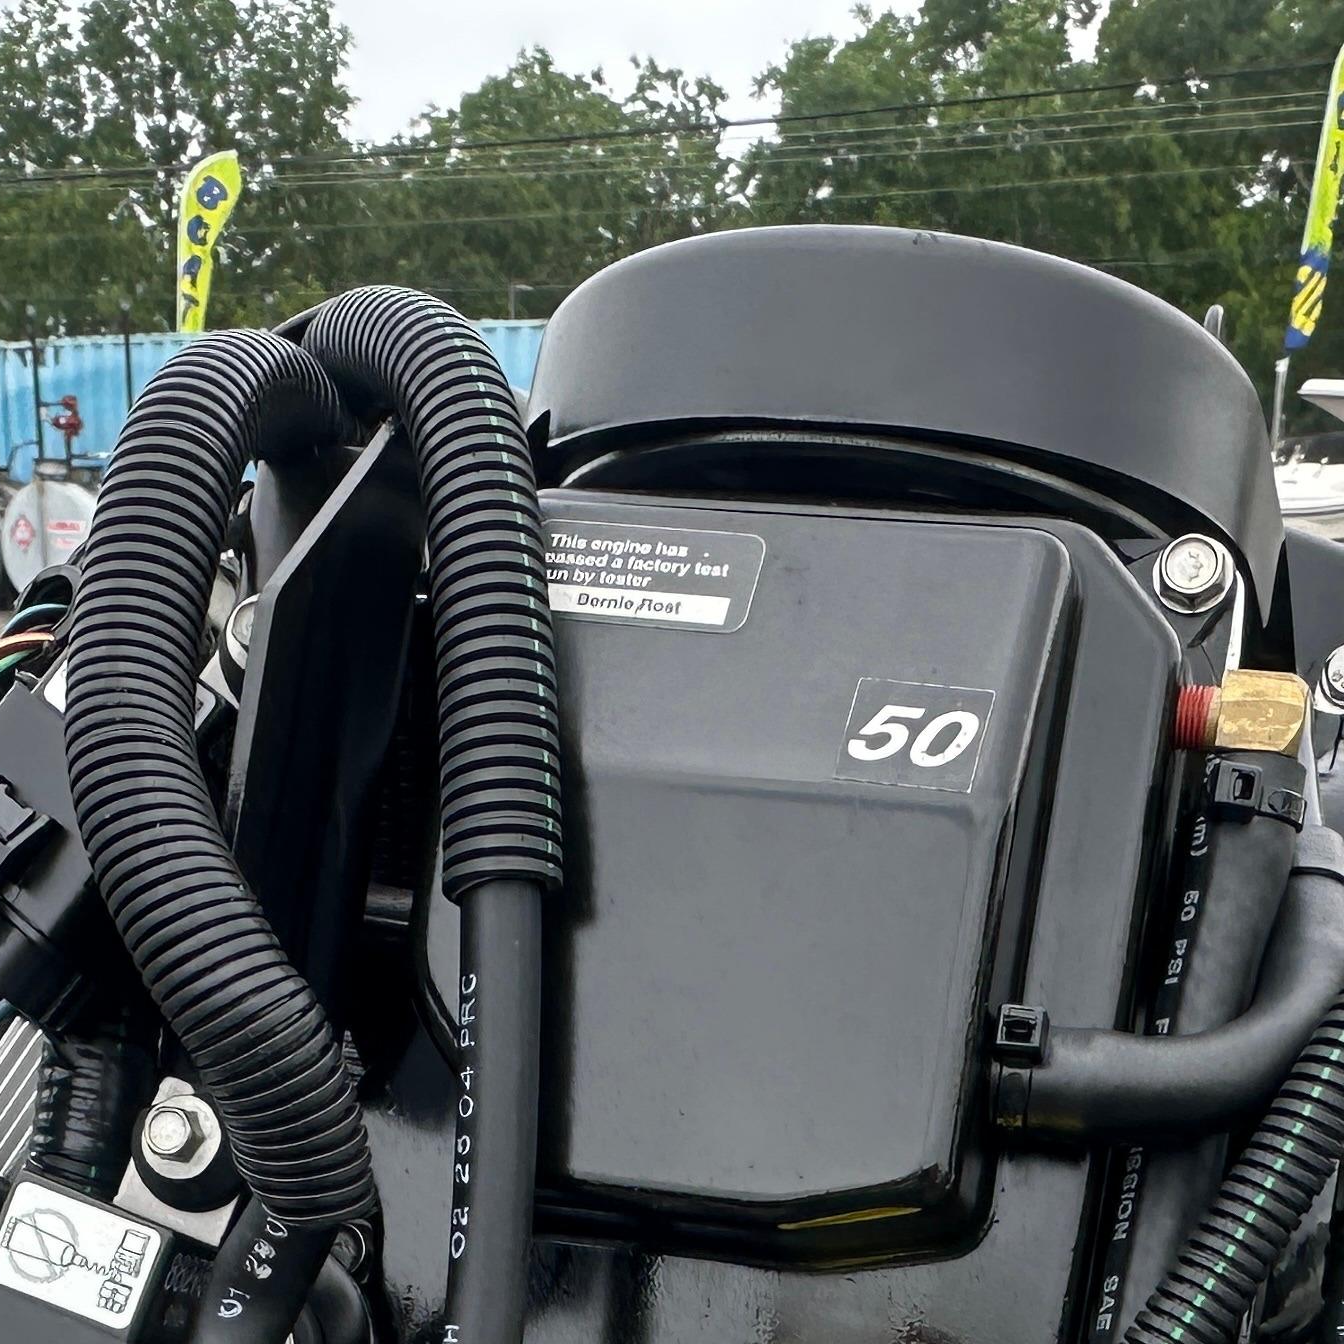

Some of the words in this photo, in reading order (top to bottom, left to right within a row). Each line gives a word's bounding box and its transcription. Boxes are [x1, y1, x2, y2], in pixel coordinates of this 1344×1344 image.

[551, 533, 587, 549] This
[591, 539, 653, 556] engine
[656, 541, 689, 557] has
[611, 556, 623, 569] a
[627, 556, 691, 577] factory
[695, 562, 730, 577] test
[546, 570, 568, 581] un
[573, 569, 596, 586] by
[600, 573, 652, 587] tester
[848, 703, 980, 767] 50
[1165, 938, 1188, 985] PSI
[459, 973, 478, 1048] PRC
[1156, 1016, 1170, 1033] F
[457, 1065, 475, 1118] 04
[1112, 1147, 1143, 1241] ISSION
[451, 1206, 470, 1260] 02
[1096, 1275, 1120, 1331] SAE
[443, 1324, 459, 1344] H
